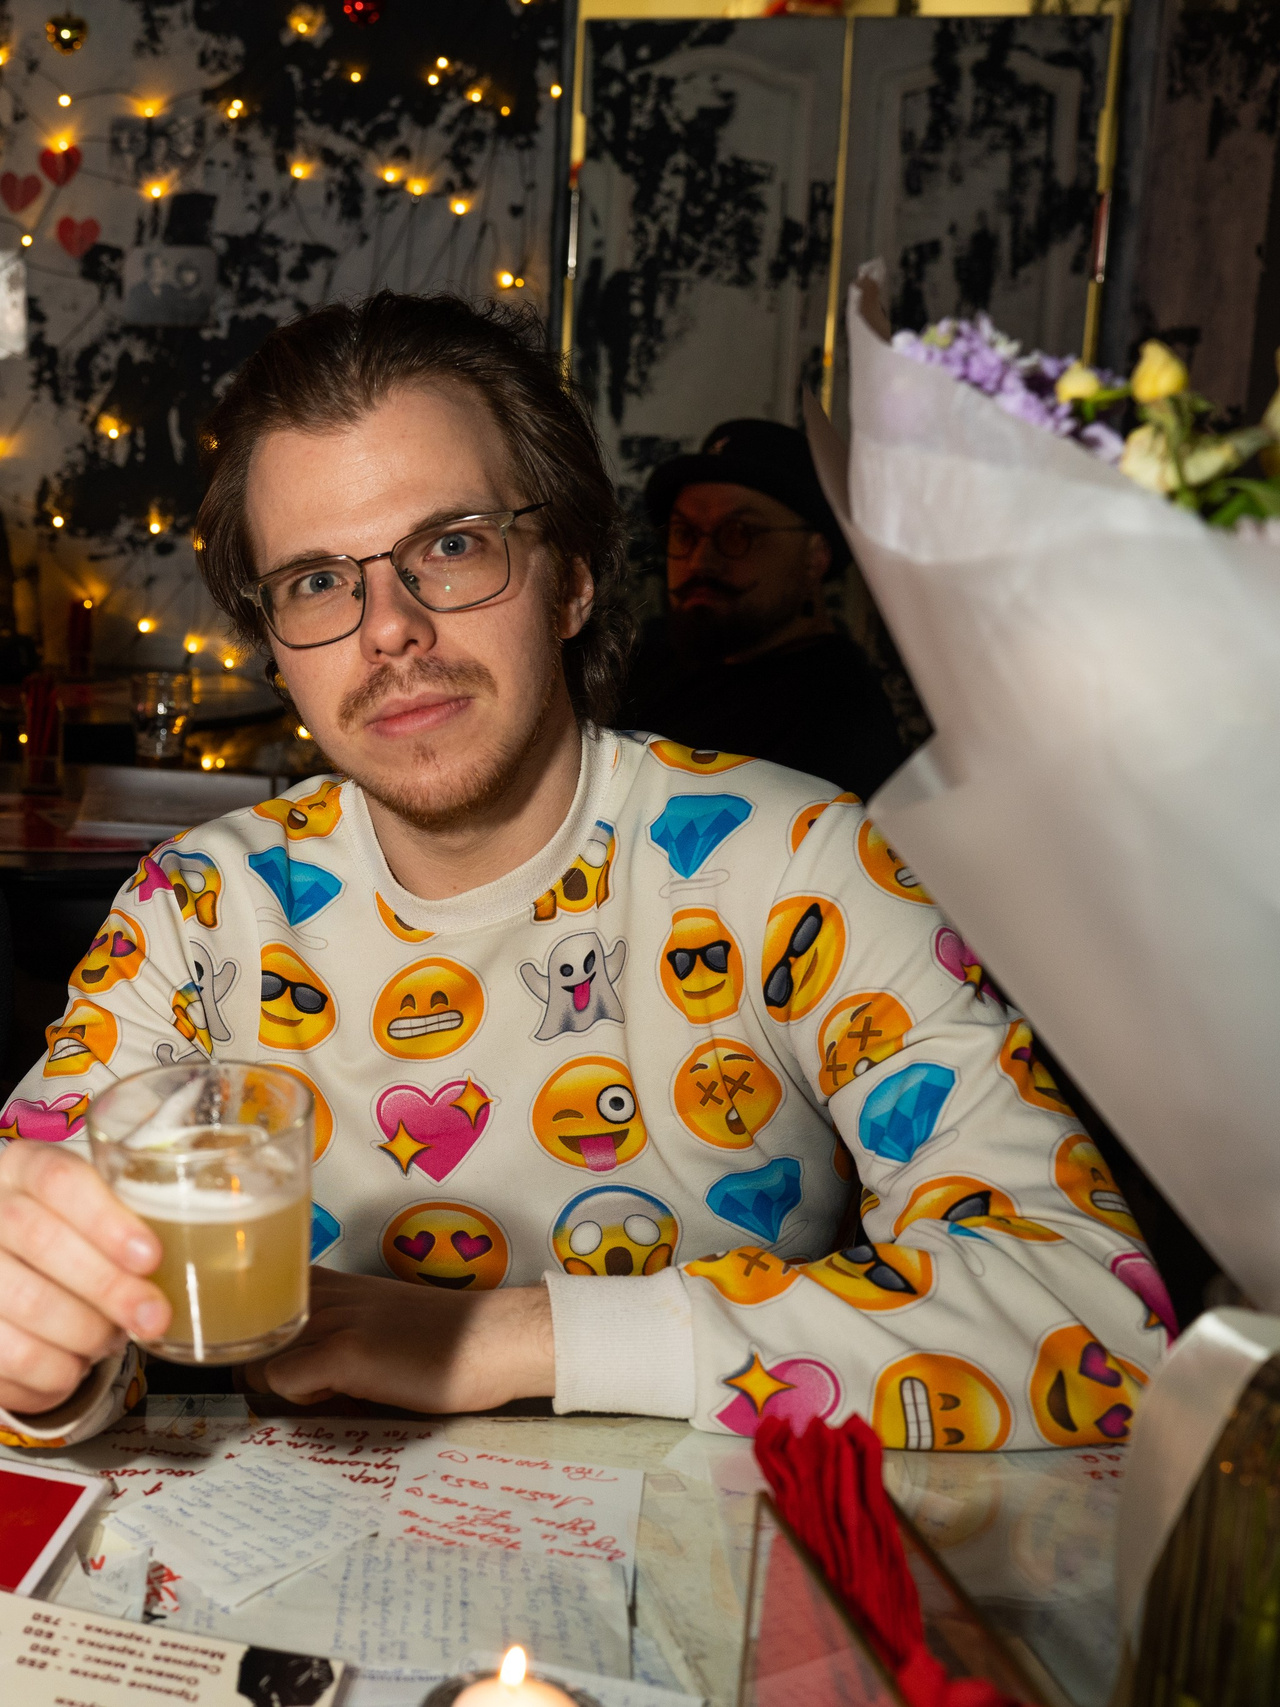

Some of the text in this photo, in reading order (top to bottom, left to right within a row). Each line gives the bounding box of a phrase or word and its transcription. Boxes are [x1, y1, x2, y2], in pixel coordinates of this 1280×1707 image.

[83, 1624, 152, 1645] тарелка
[76, 1638, 145, 1659] тарелка
[159, 1640, 226, 1661] Мясная
[152, 1654, 221, 1675] Сырная
[133, 1665, 199, 1686] Оливки
